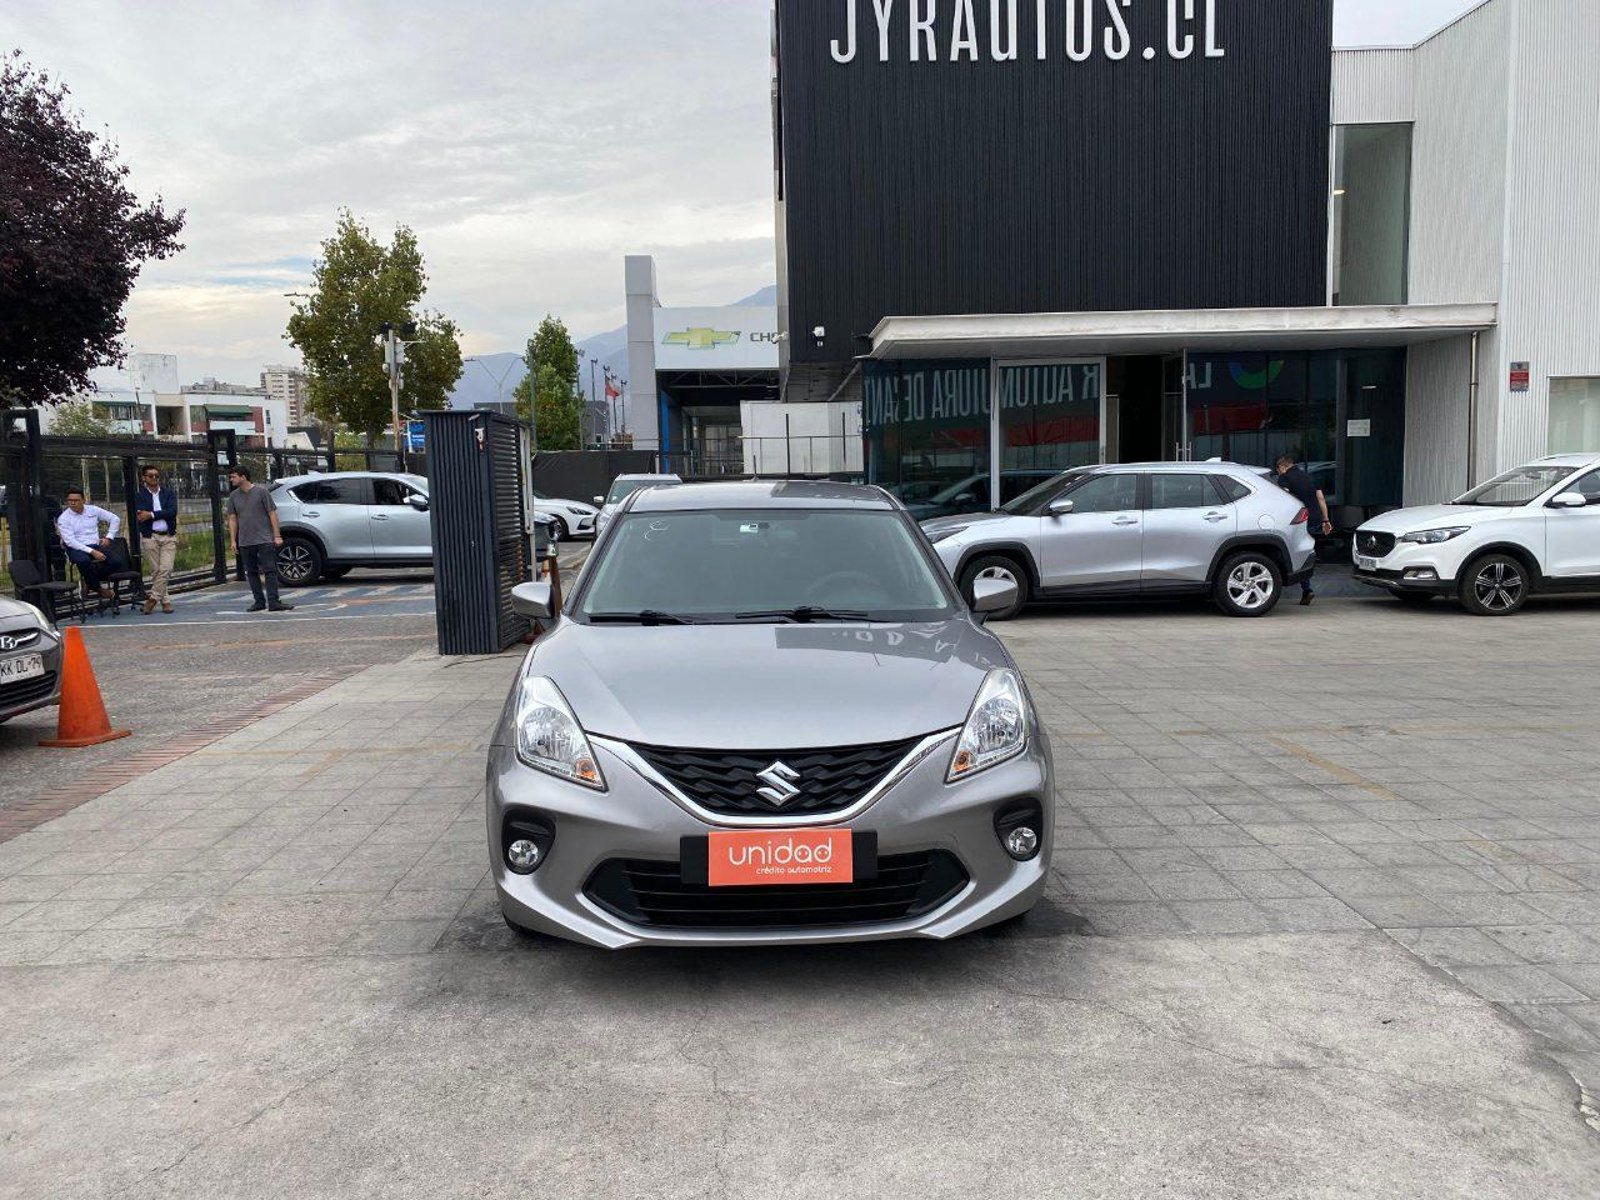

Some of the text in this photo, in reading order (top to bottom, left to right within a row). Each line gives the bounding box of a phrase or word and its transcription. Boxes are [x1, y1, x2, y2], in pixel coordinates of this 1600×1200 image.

[829, 0, 1226, 63] JYRAUTOS.CL
[729, 837, 832, 865] unidad
[756, 865, 832, 875] crédito automotriz
